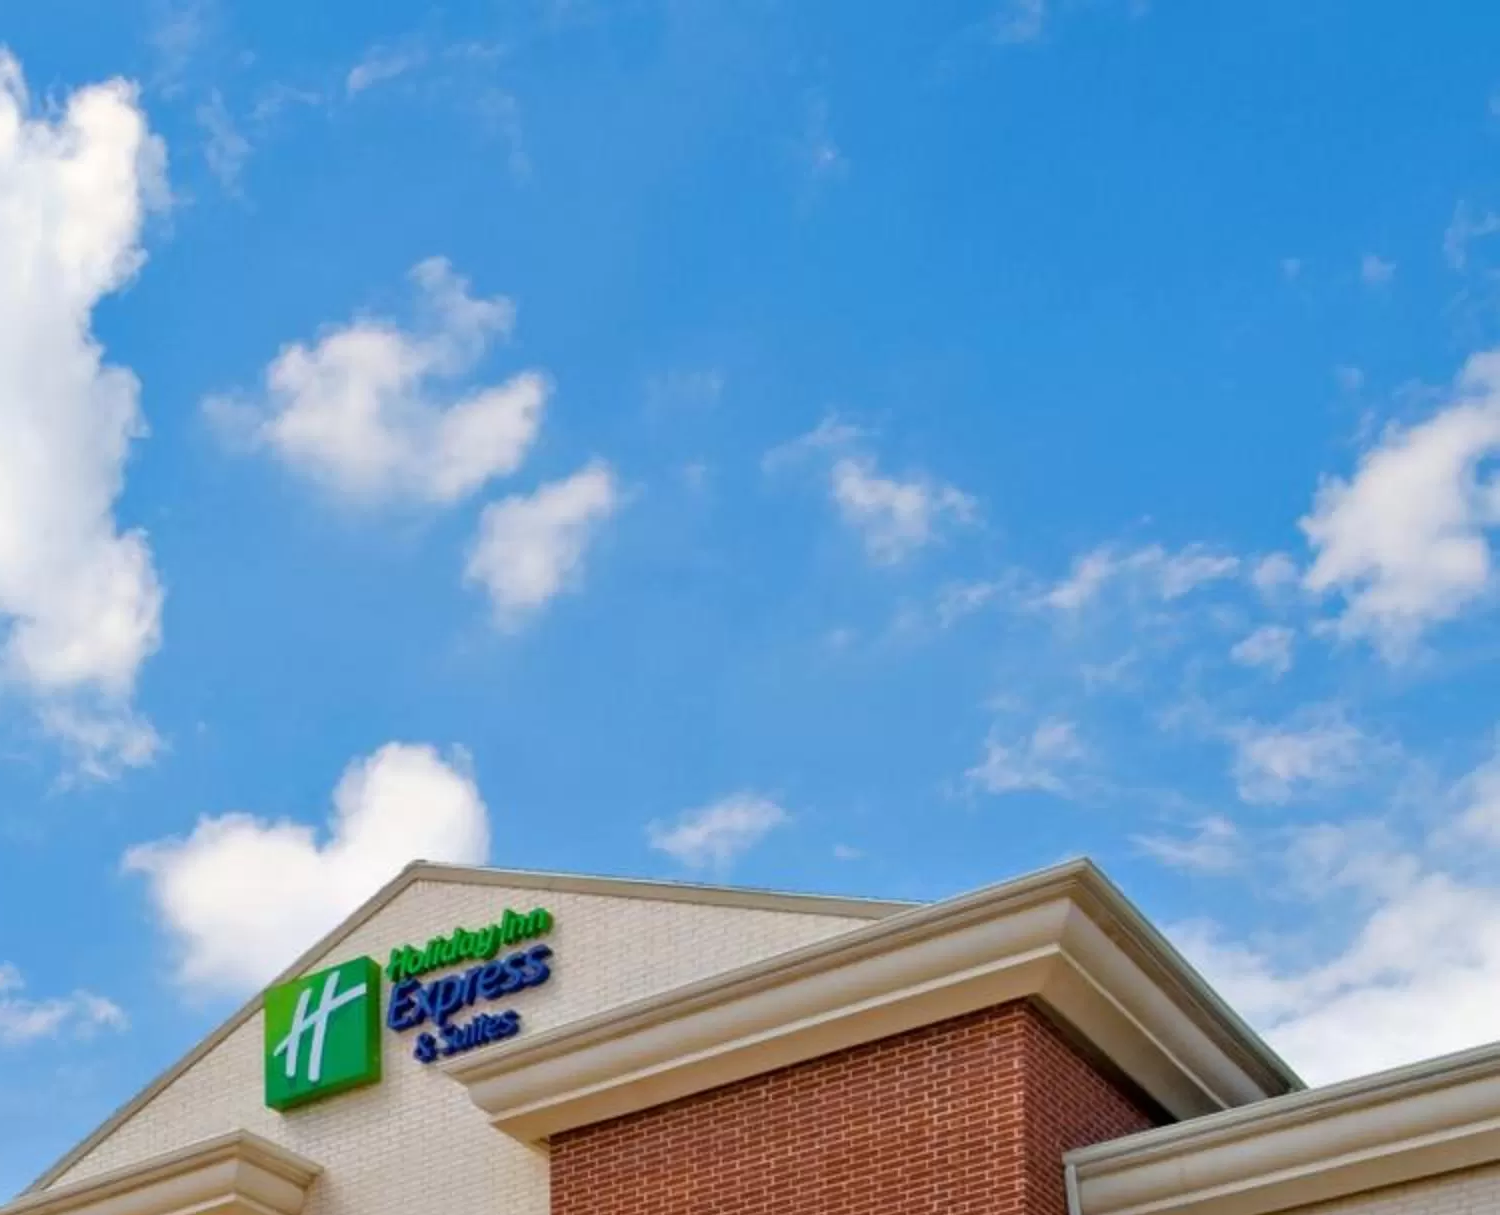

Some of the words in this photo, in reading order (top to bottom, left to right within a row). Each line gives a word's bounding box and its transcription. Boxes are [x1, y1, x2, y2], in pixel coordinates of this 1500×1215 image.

[387, 926, 499, 982] Holiday
[500, 907, 554, 945] Inn
[387, 943, 553, 1034] Express
[414, 1032, 438, 1064] &
[438, 1009, 521, 1057] Suites
